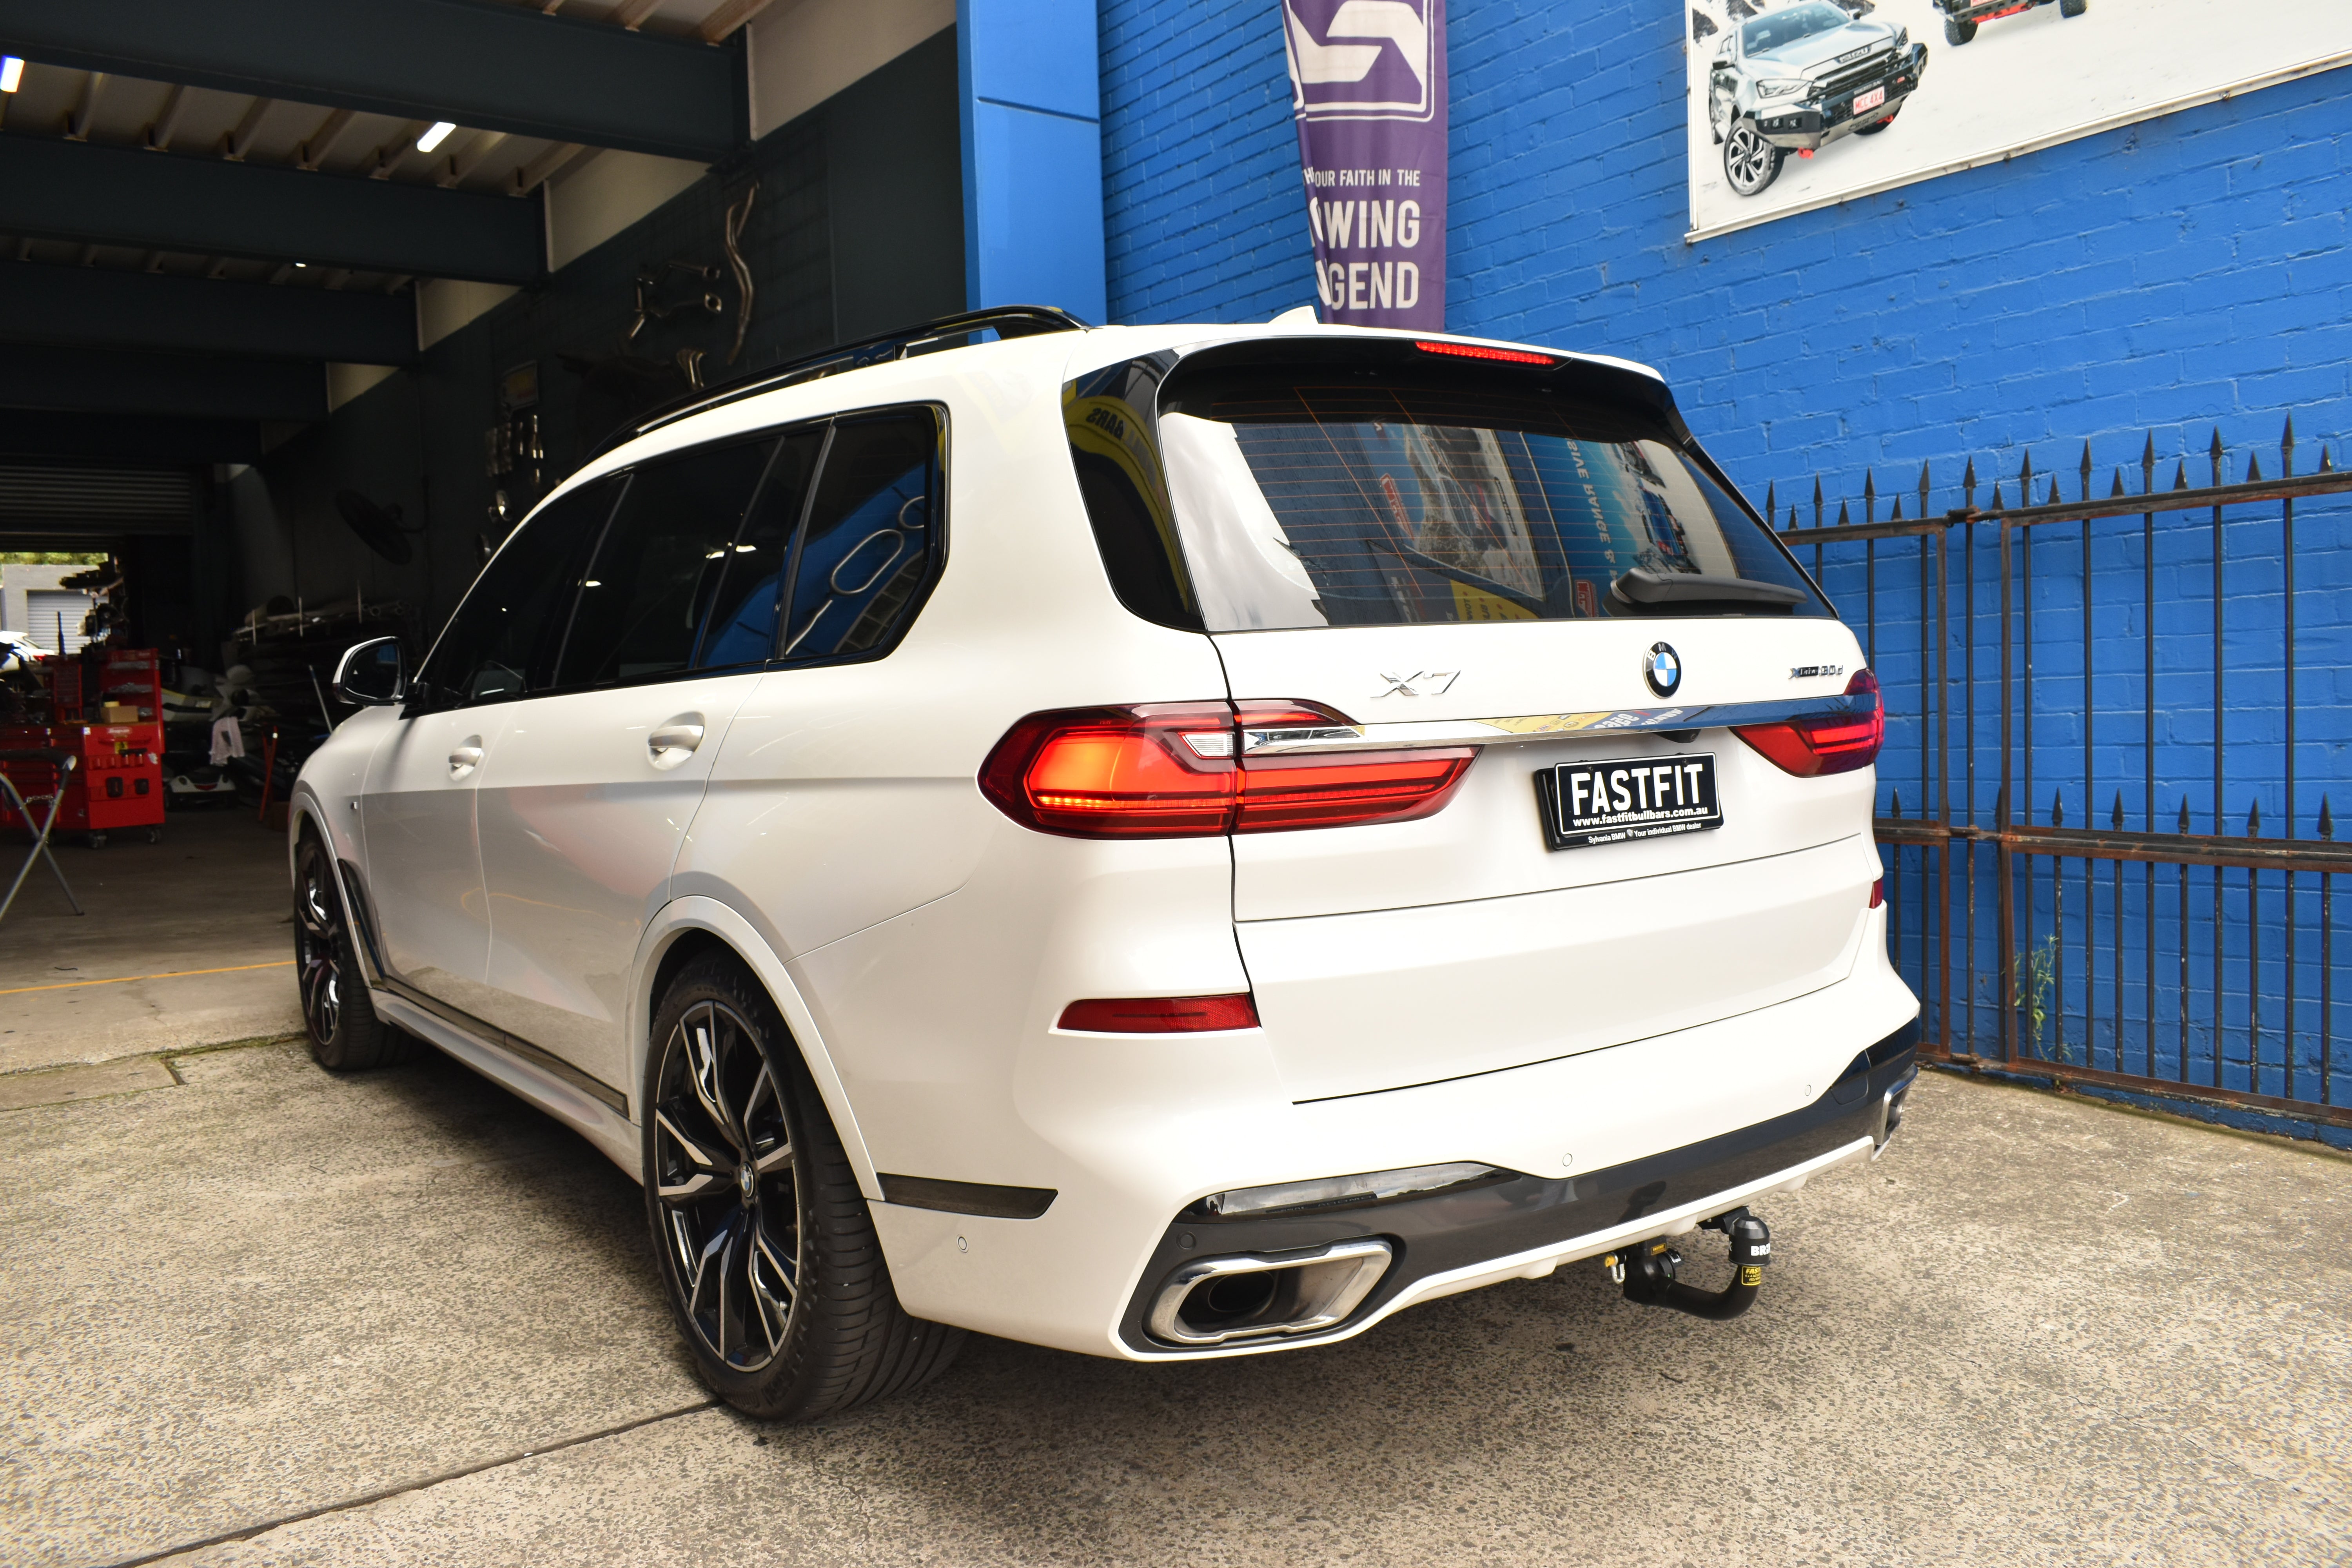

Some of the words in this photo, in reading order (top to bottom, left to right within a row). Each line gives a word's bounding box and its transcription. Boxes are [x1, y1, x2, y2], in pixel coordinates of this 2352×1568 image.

[1855, 97, 1868, 109] MCC
[1870, 91, 1883, 103] 4X4
[1315, 170, 1336, 188] OUR
[1340, 169, 1375, 187] FAITH
[1378, 169, 1391, 186] IN
[1397, 169, 1421, 187] THE
[1319, 200, 1420, 249] WING
[1328, 261, 1419, 310] GEND
[1370, 670, 1461, 698] X7
[1571, 763, 1703, 816] FASTFIT
[1573, 807, 1708, 827] www.fastfitbullbars.com.au
[1588, 834, 1611, 844] Sylvania
[1611, 832, 1626, 840] BMW
[1647, 826, 1672, 836] individual
[1672, 823, 1686, 832] BMW
